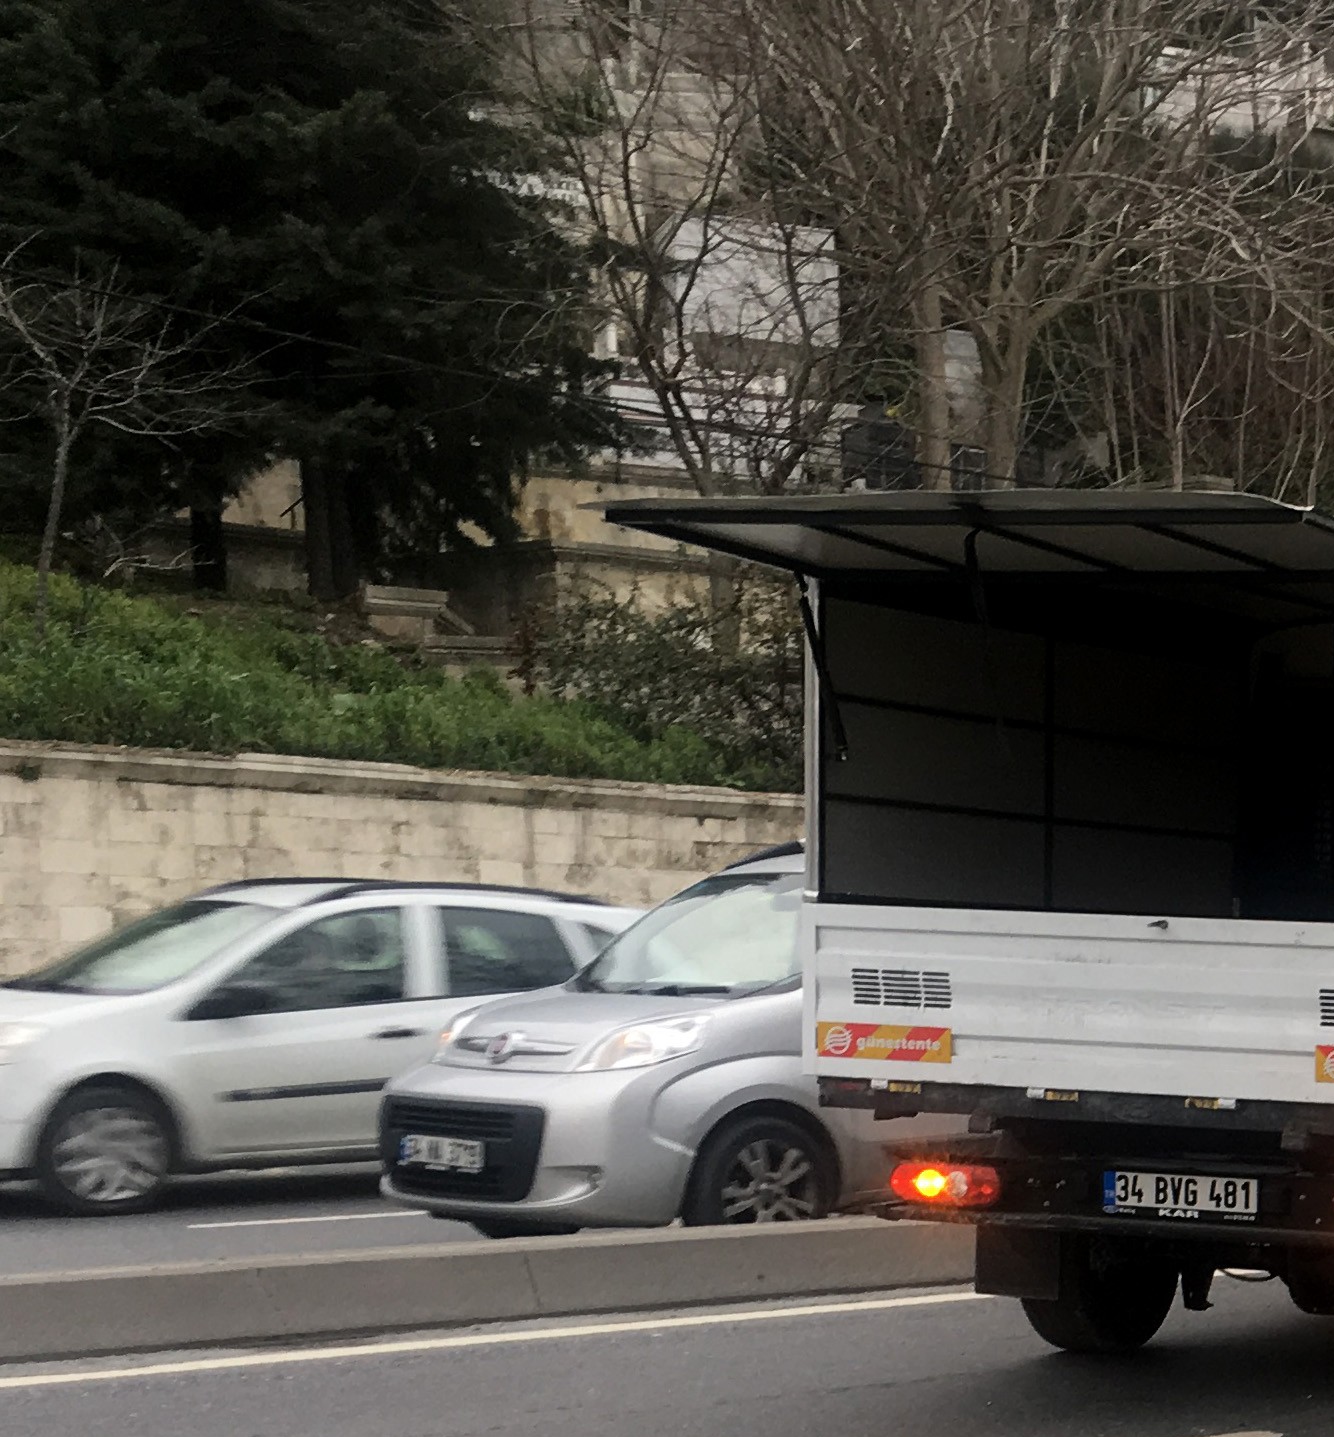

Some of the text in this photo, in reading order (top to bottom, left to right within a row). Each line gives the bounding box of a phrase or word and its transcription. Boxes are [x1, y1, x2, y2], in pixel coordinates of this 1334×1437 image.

[1116, 1174, 1144, 1204] 34
[1154, 1176, 1199, 1207] BVG
[1209, 1179, 1252, 1211] 481
